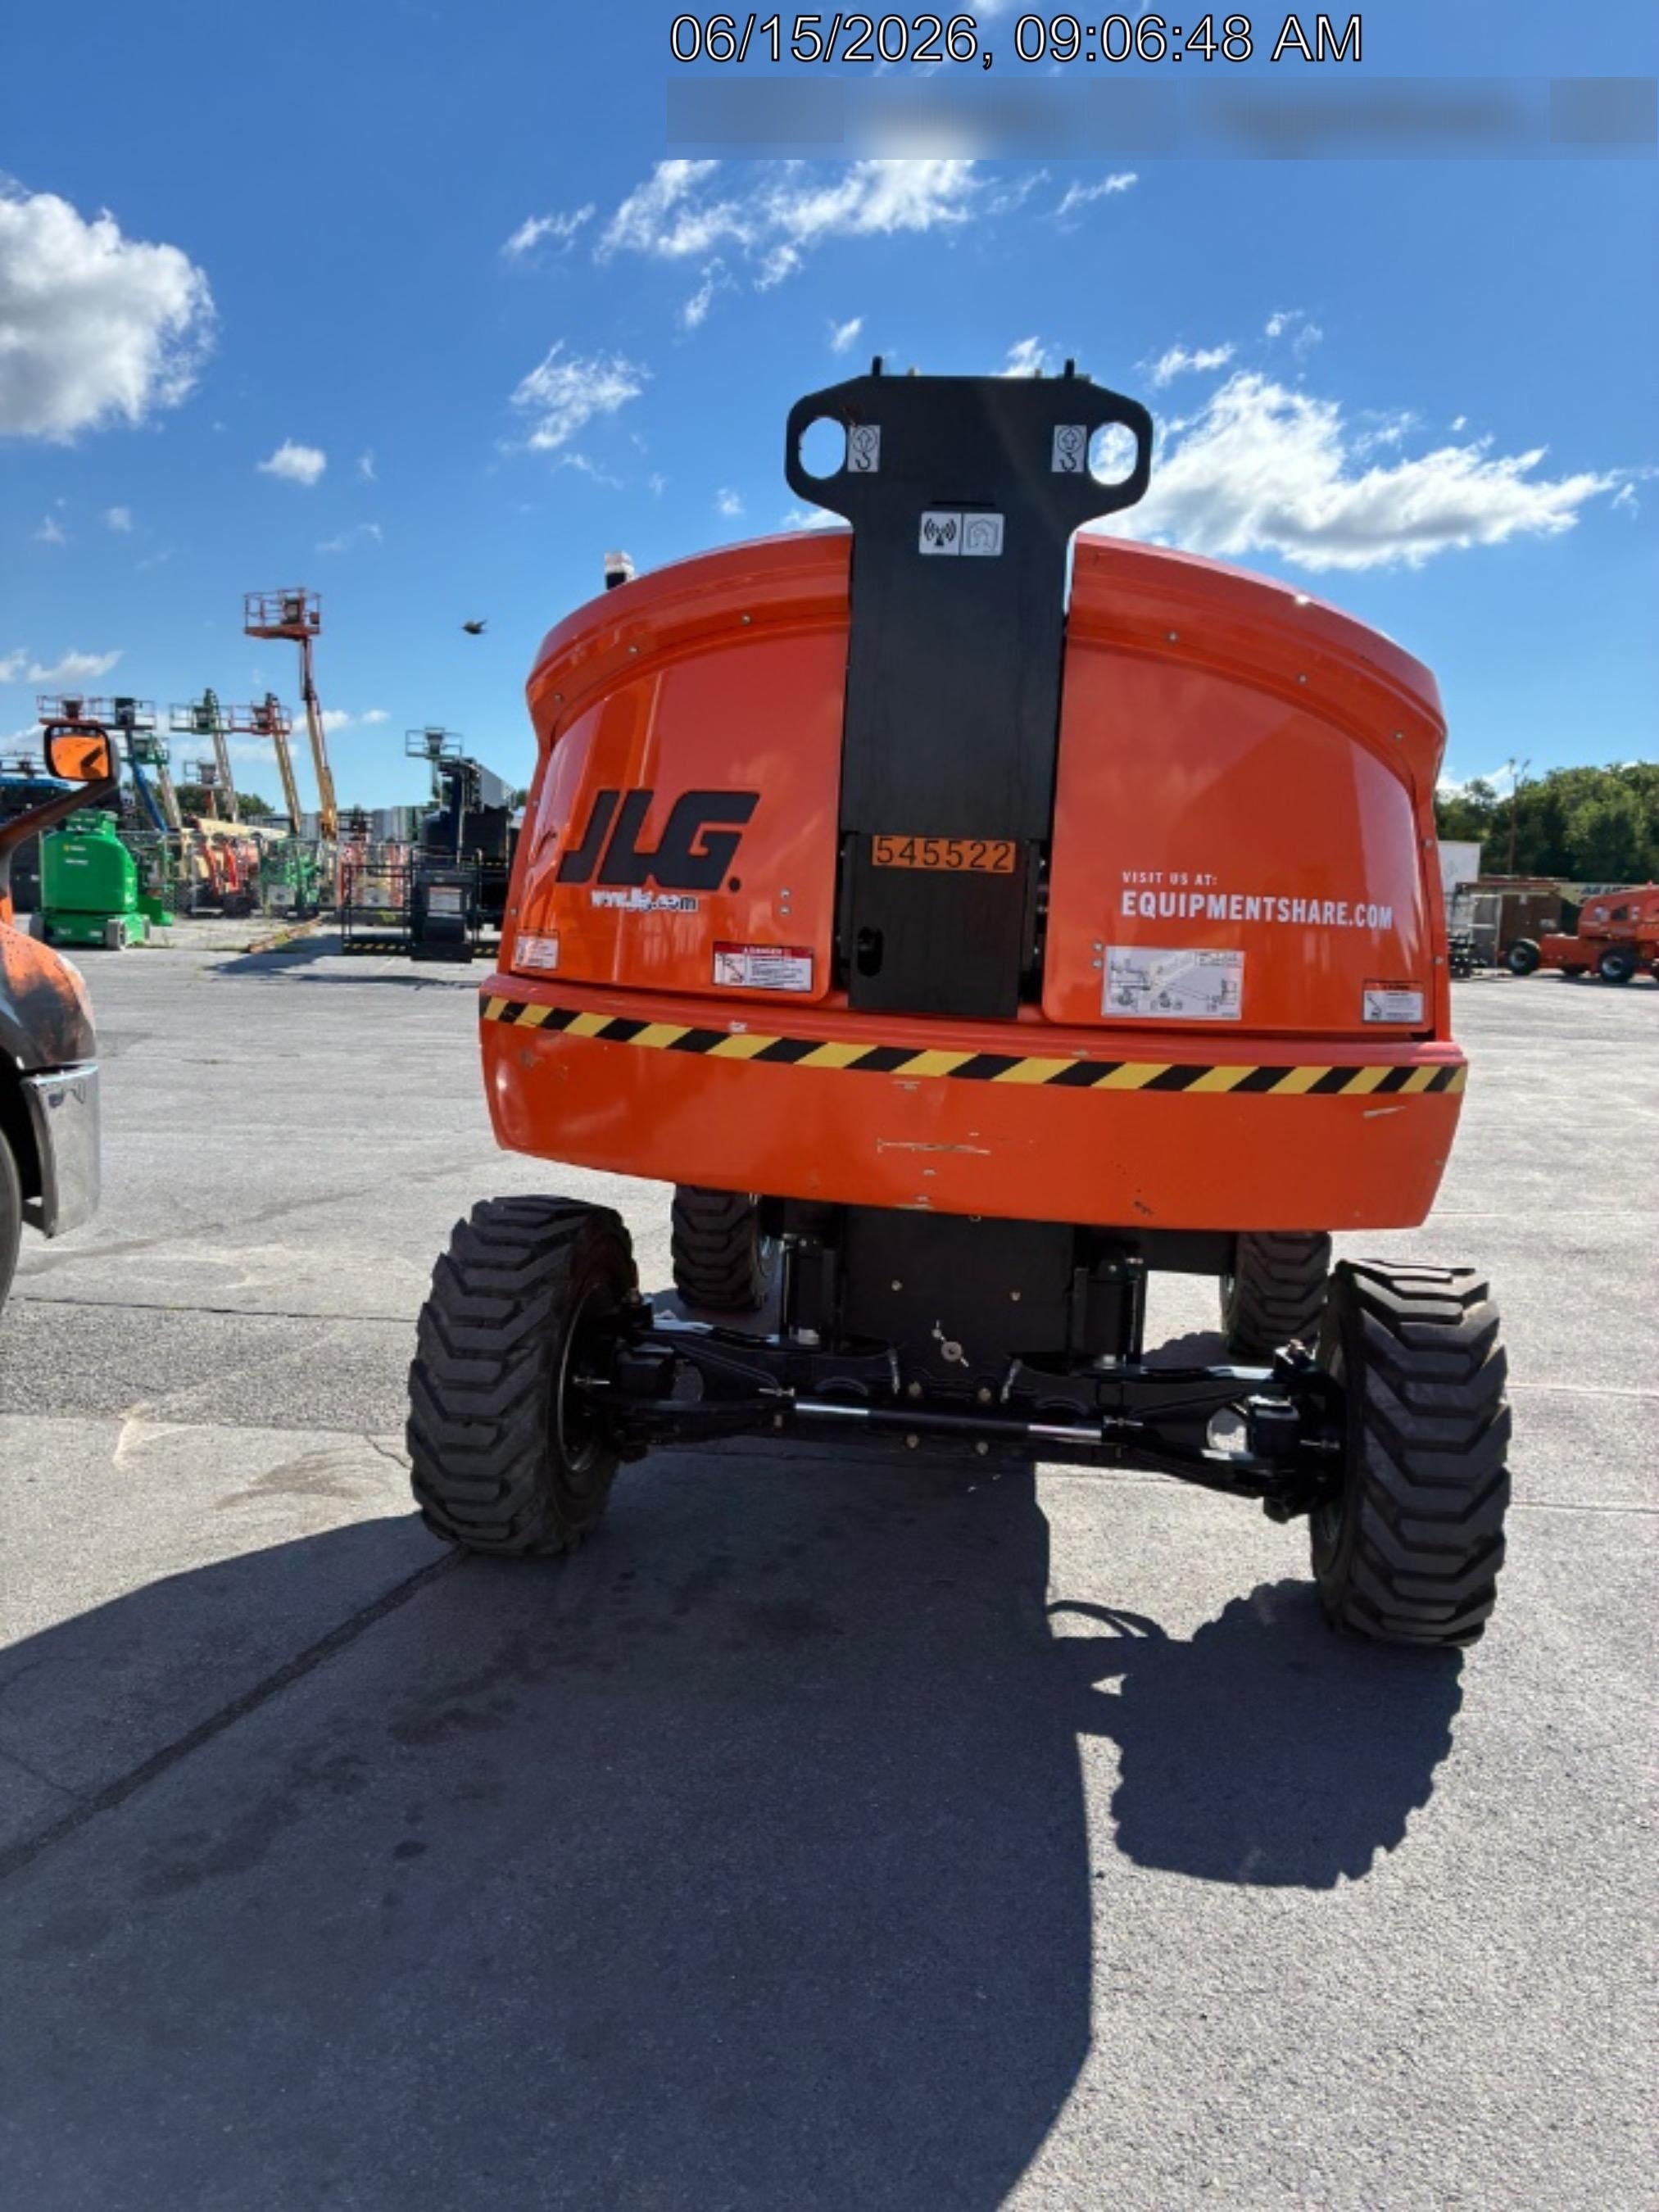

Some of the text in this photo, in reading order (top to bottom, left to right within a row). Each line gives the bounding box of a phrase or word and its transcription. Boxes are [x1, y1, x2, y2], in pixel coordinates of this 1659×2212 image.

[877, 836, 1011, 871] 545522
[1122, 871, 1217, 886] VISIT US AT:
[1122, 890, 1393, 930] EQUIPMENTSHARE.COM
